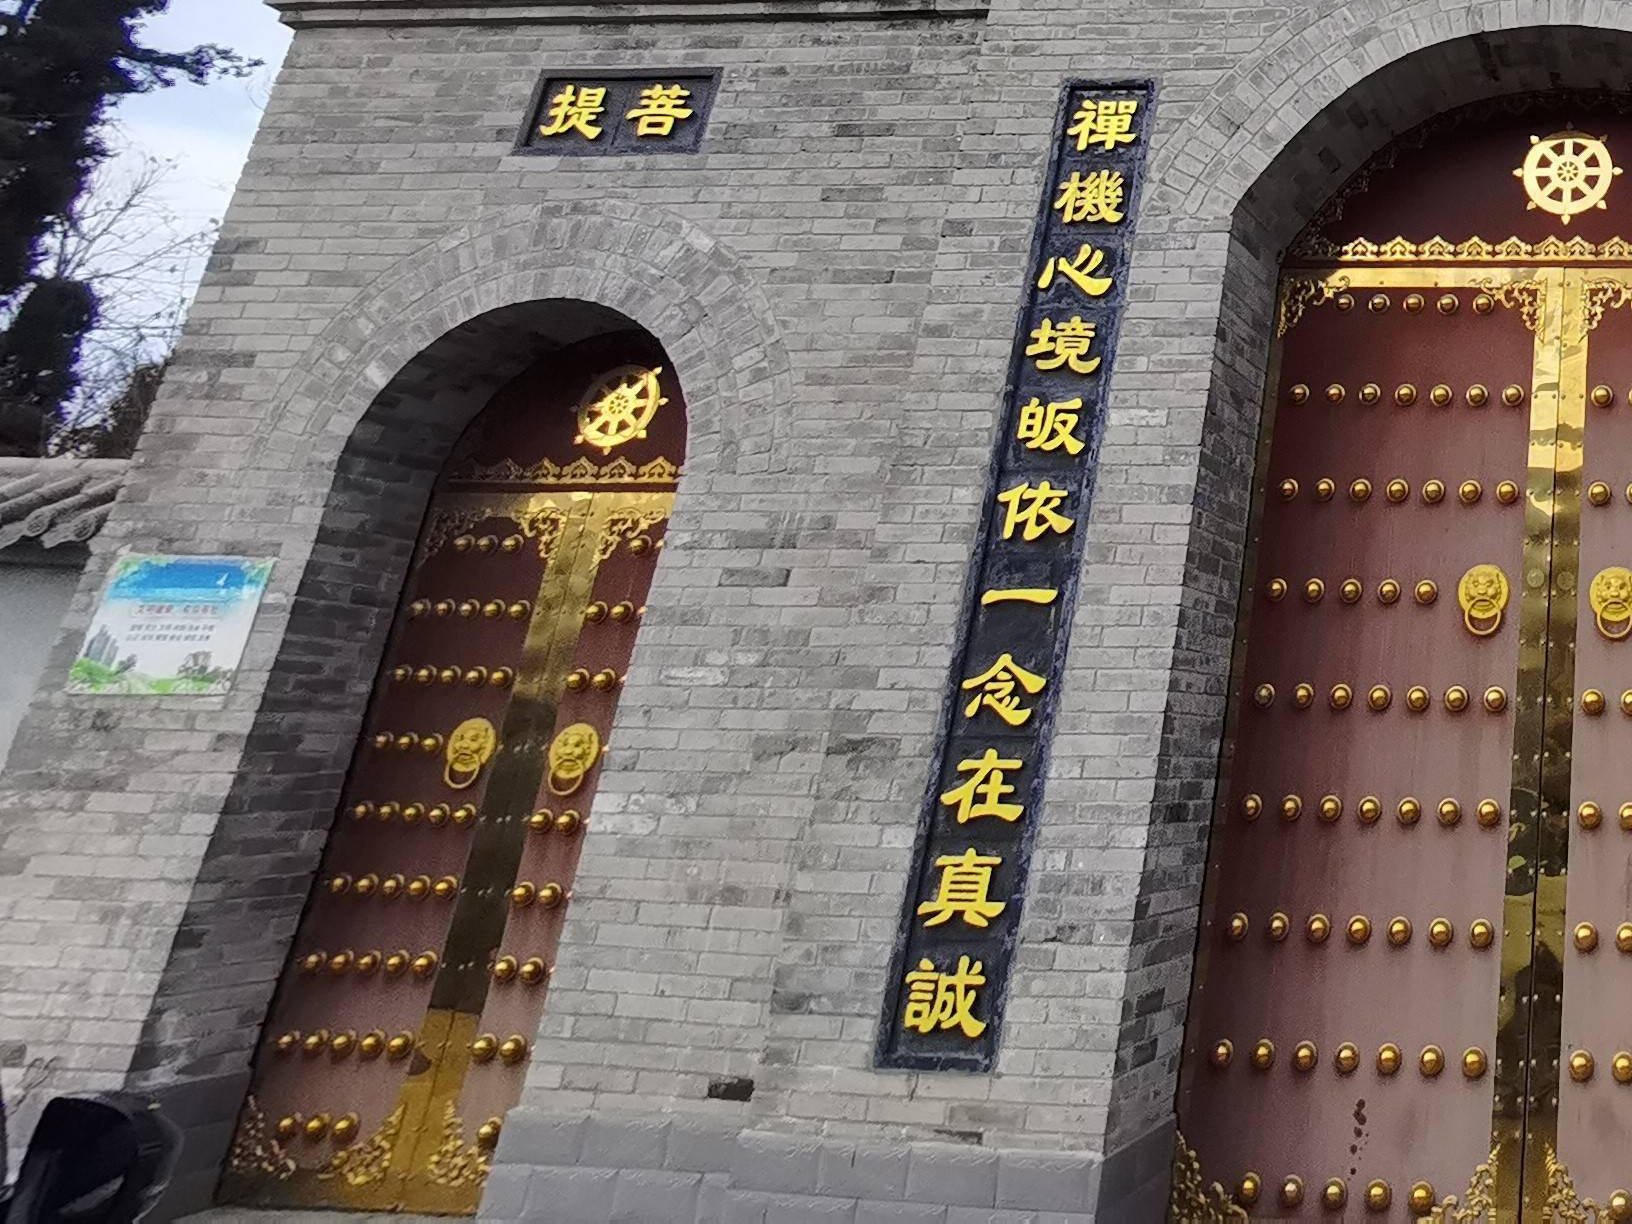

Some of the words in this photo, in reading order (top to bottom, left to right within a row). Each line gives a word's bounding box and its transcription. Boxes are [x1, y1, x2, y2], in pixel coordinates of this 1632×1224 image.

[539, 84, 693, 140] 菩提
[903, 99, 1138, 1039] 禪機心境皈依一念在真誠
